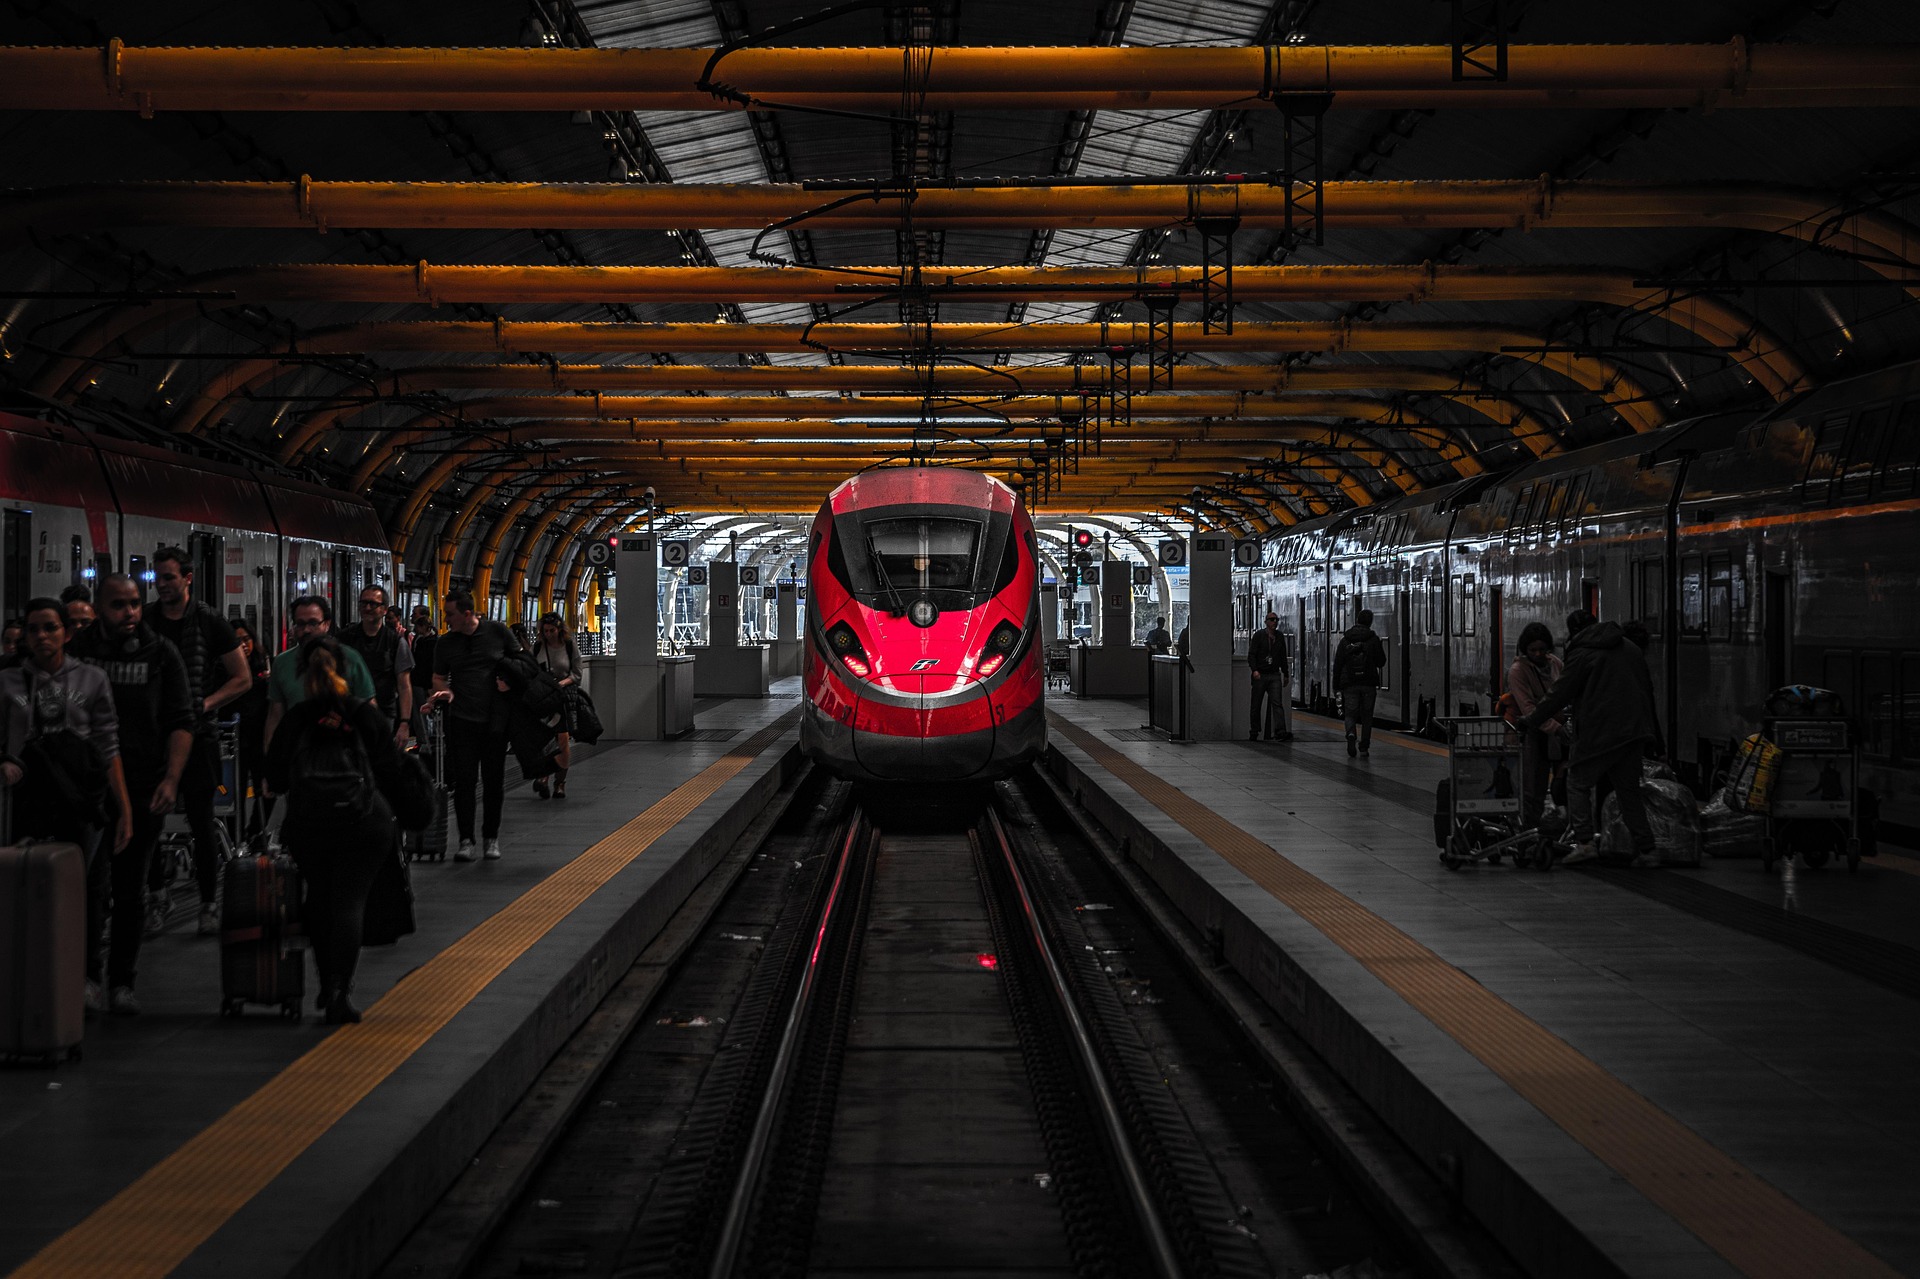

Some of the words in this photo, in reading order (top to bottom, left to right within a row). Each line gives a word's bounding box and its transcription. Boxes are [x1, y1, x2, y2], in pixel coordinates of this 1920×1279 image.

[593, 543, 605, 561] 3
[669, 546, 681, 561] 2
[1166, 546, 1178, 561] 2
[1245, 546, 1252, 561] 1
[693, 570, 702, 581] 3
[745, 570, 754, 581] 2
[1086, 570, 1095, 581] 2
[1140, 571, 1146, 581] 1
[766, 589, 773, 597] 3
